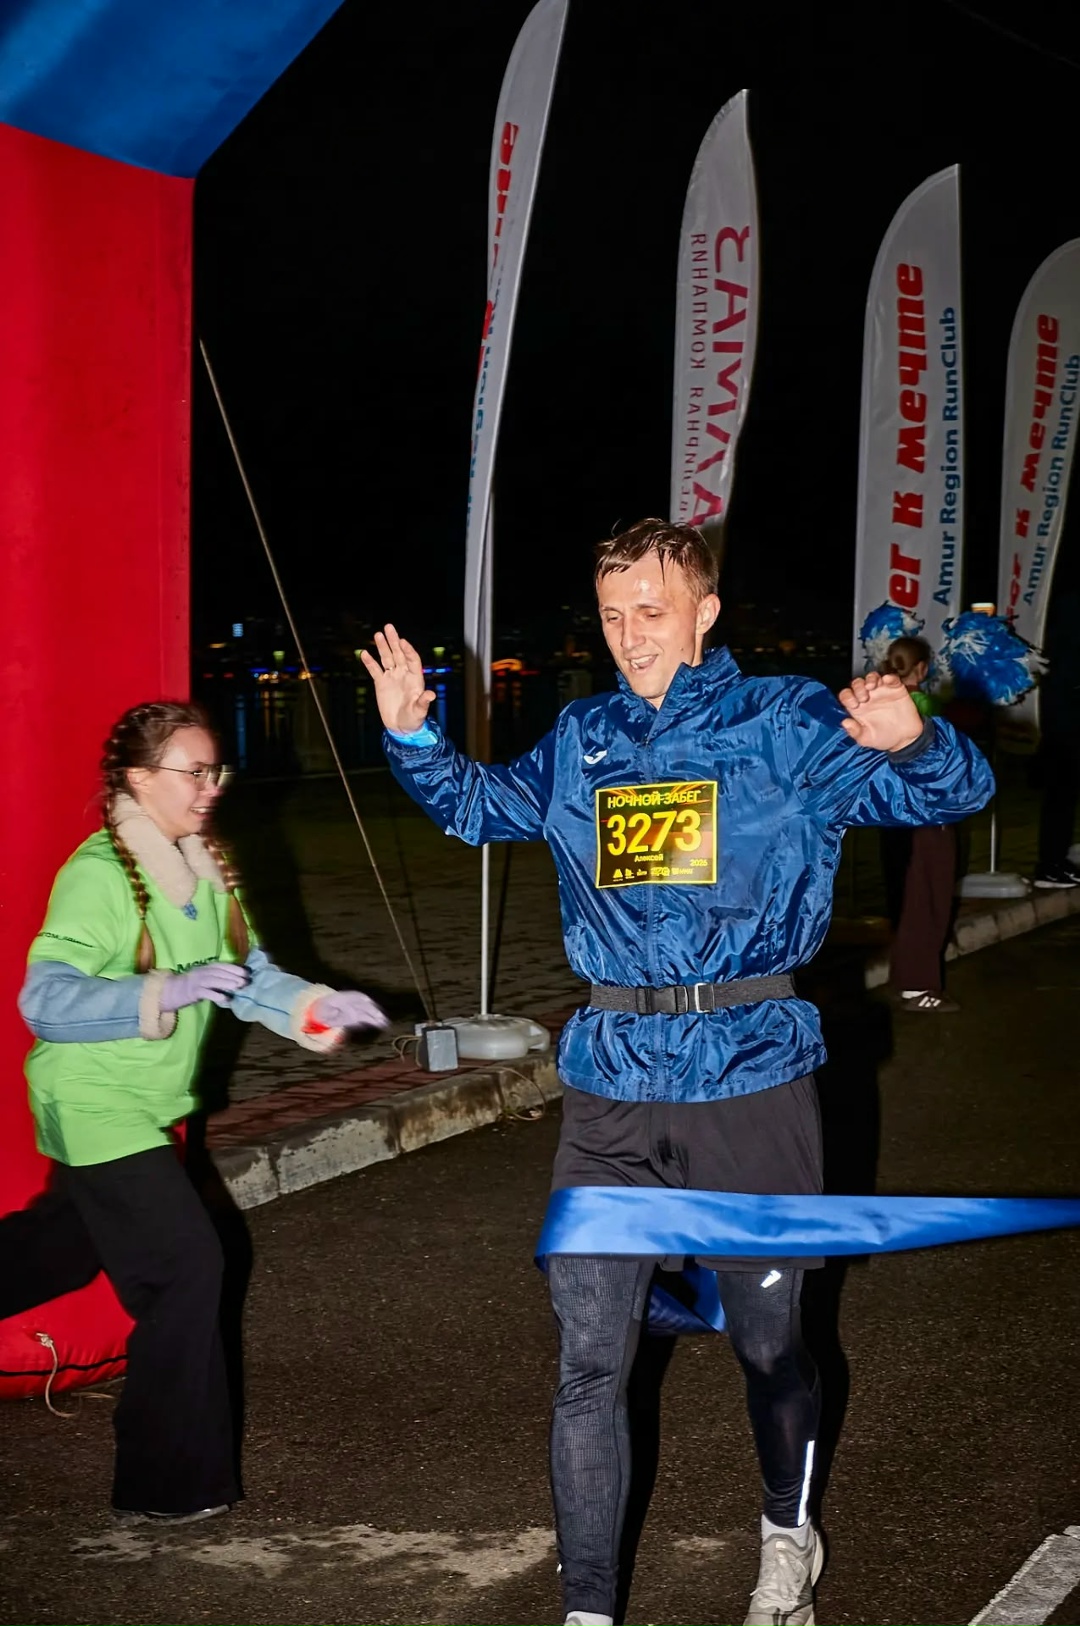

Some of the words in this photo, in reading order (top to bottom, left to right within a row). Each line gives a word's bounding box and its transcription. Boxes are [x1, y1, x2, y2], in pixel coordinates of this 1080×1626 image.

[897, 263, 927, 474] мечте
[939, 307, 958, 421] RunClub
[1020, 313, 1059, 493] мечте
[939, 427, 960, 524] Region
[1023, 543, 1046, 606] Amur
[1037, 456, 1064, 537] Region
[1051, 354, 1079, 450] RunClub
[889, 543, 921, 610] ег
[932, 531, 955, 606] Amur
[606, 809, 702, 856] 3273
[607, 791, 660, 809] НОЧНОЙ
[663, 790, 701, 805] ЗАБЕГ
